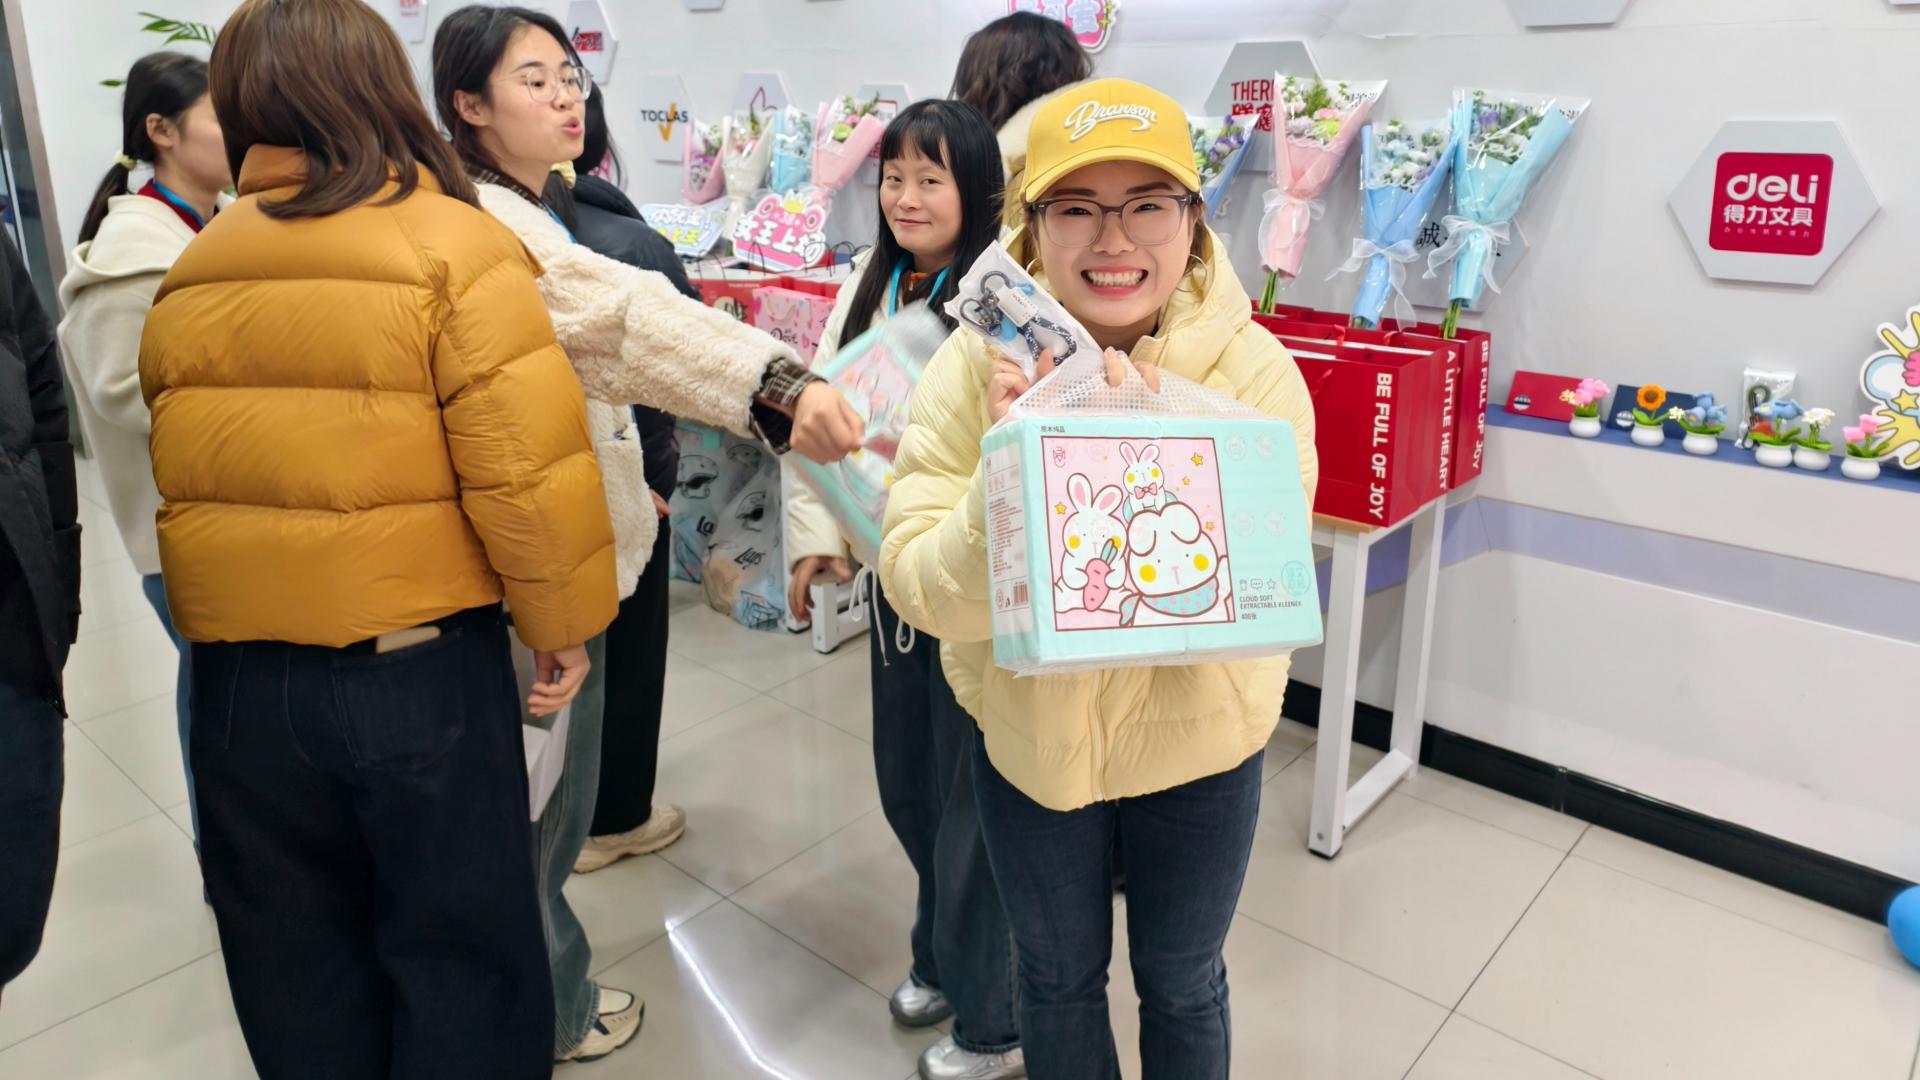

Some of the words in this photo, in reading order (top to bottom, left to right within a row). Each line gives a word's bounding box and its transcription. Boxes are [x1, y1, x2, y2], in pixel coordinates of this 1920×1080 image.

[1231, 79, 1275, 101] THER
[640, 110, 688, 123] TOCLAS
[1726, 173, 1819, 204] deli
[1723, 204, 1814, 227] 得力文具
[1447, 350, 1456, 363] A
[1481, 340, 1489, 363] BE
[1376, 372, 1392, 398] BE
[1444, 368, 1454, 428] LITTLE
[1479, 367, 1488, 408] FULL
[1374, 403, 1390, 447] FULL
[1477, 412, 1485, 434] OF
[1371, 453, 1387, 479] OF
[1439, 432, 1450, 490] HEART
[1472, 440, 1483, 469] JOY
[1369, 483, 1385, 520] JOY
